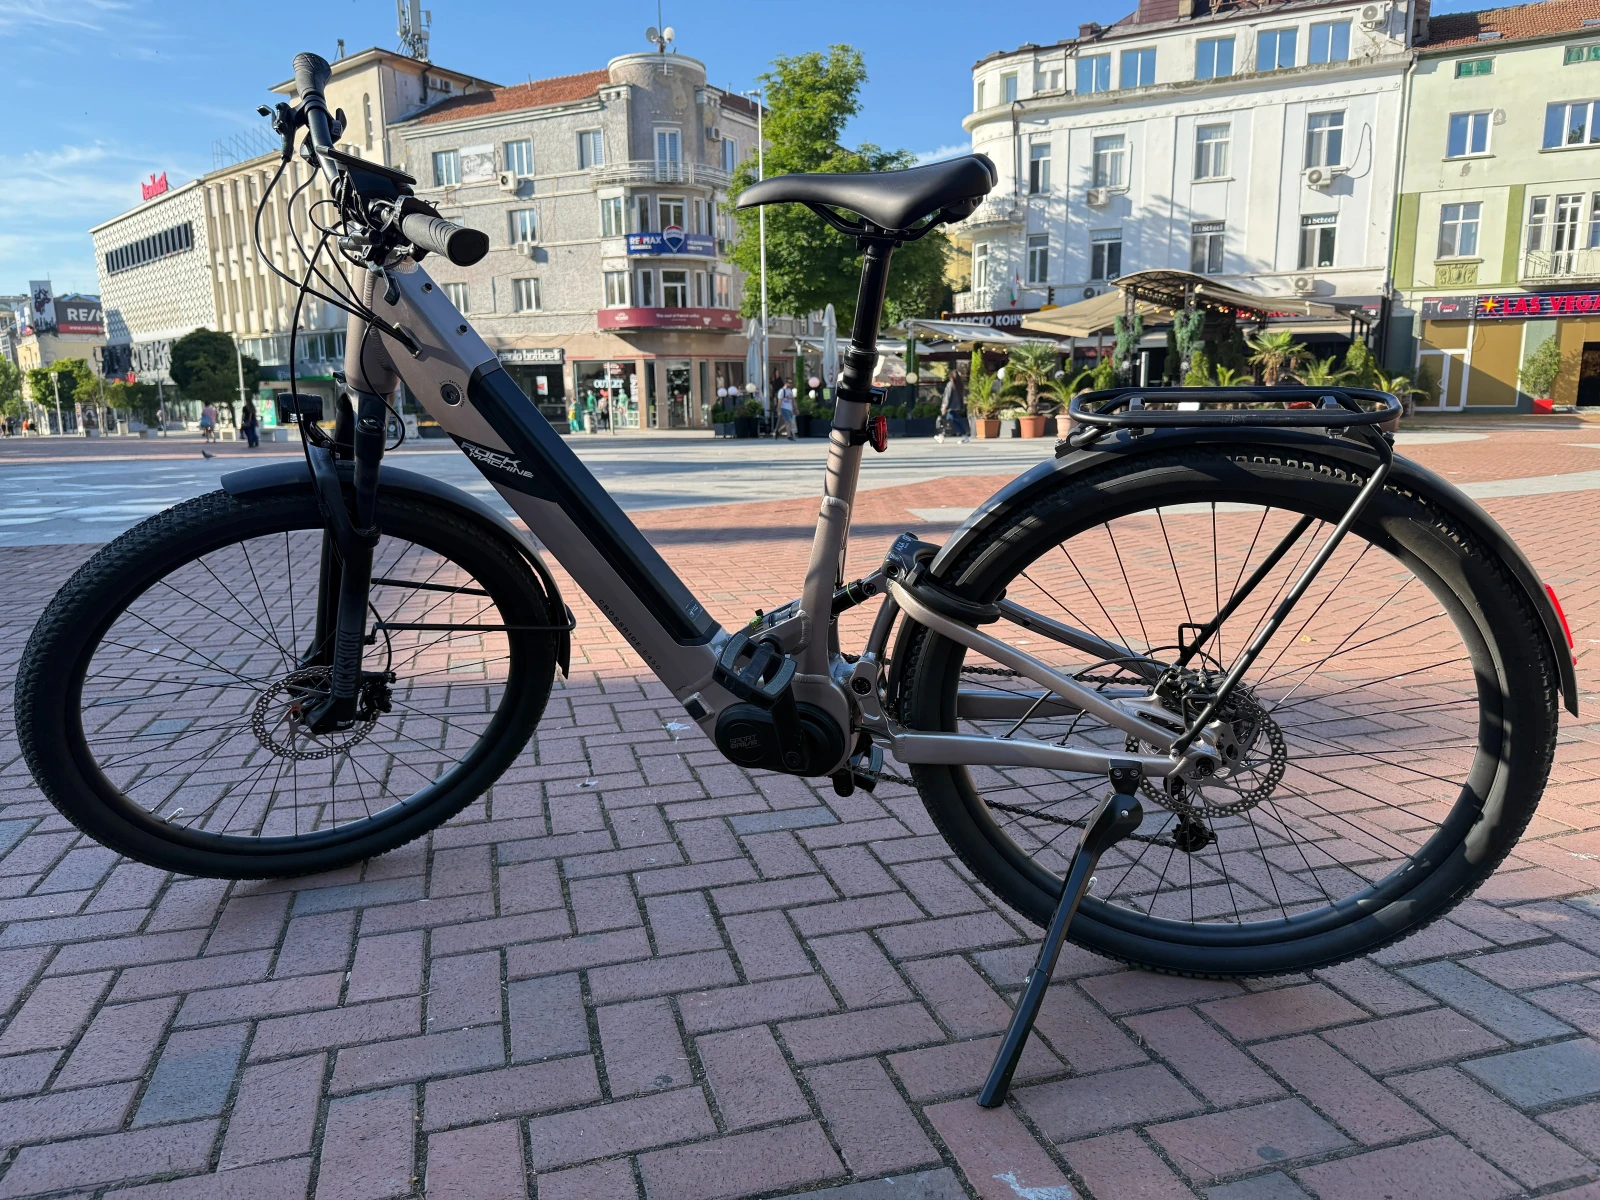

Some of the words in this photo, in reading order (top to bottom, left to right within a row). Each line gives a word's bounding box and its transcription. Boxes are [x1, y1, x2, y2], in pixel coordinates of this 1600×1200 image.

[1503, 297, 1541, 313] LAS
[460, 441, 522, 468] ROCK
[469, 452, 534, 479] MACHINE
[598, 599, 642, 648] CROSSRIDE
[642, 649, 661, 670] E450
[730, 734, 758, 743] SPORT
[730, 739, 758, 749] DRIVE
